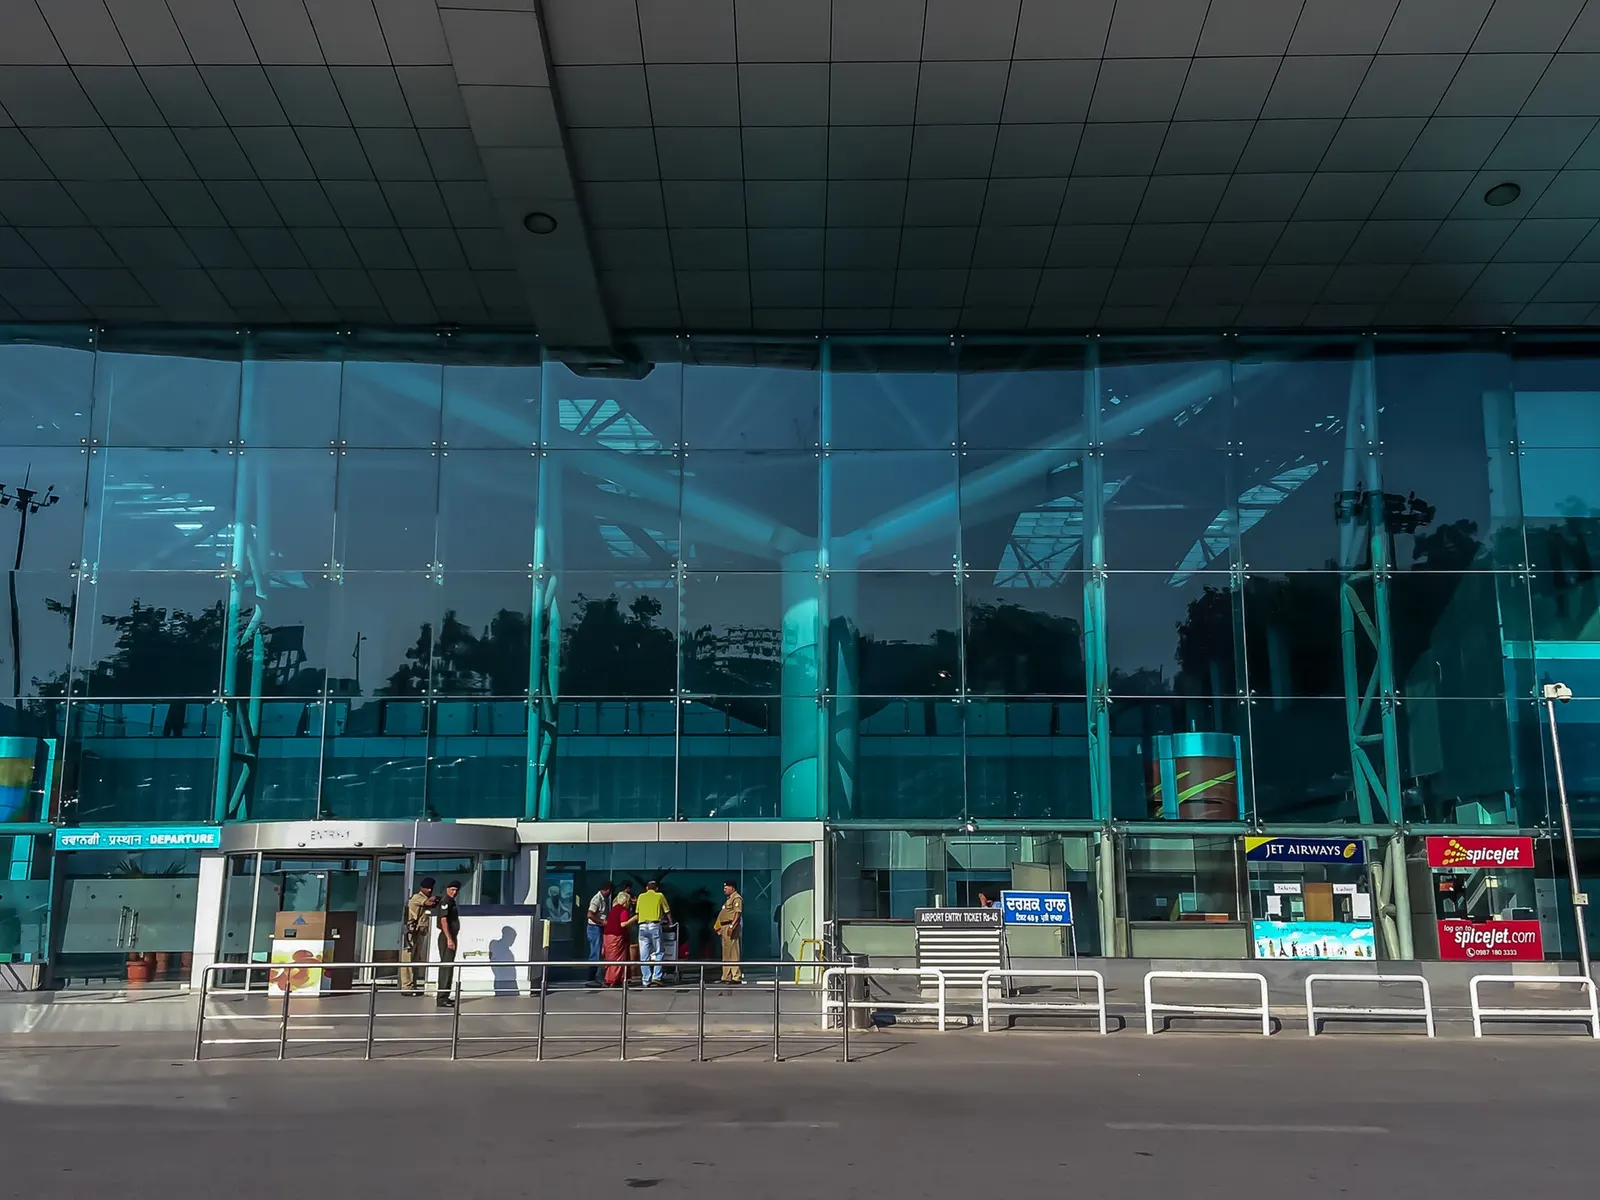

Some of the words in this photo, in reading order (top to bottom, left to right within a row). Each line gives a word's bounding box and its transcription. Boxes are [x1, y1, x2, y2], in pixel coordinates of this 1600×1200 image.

[108, 834, 142, 845] प्रस्थान
[150, 833, 214, 844] DEPARTURE
[1266, 844, 1284, 858] JET
[1288, 845, 1340, 855] AIRWAYS
[1044, 898, 1066, 912] ਹਾਲ
[921, 912, 944, 922] AIRPORT
[945, 912, 962, 922] ENTRY
[963, 912, 982, 922] TICKET
[1443, 925, 1453, 933] log
